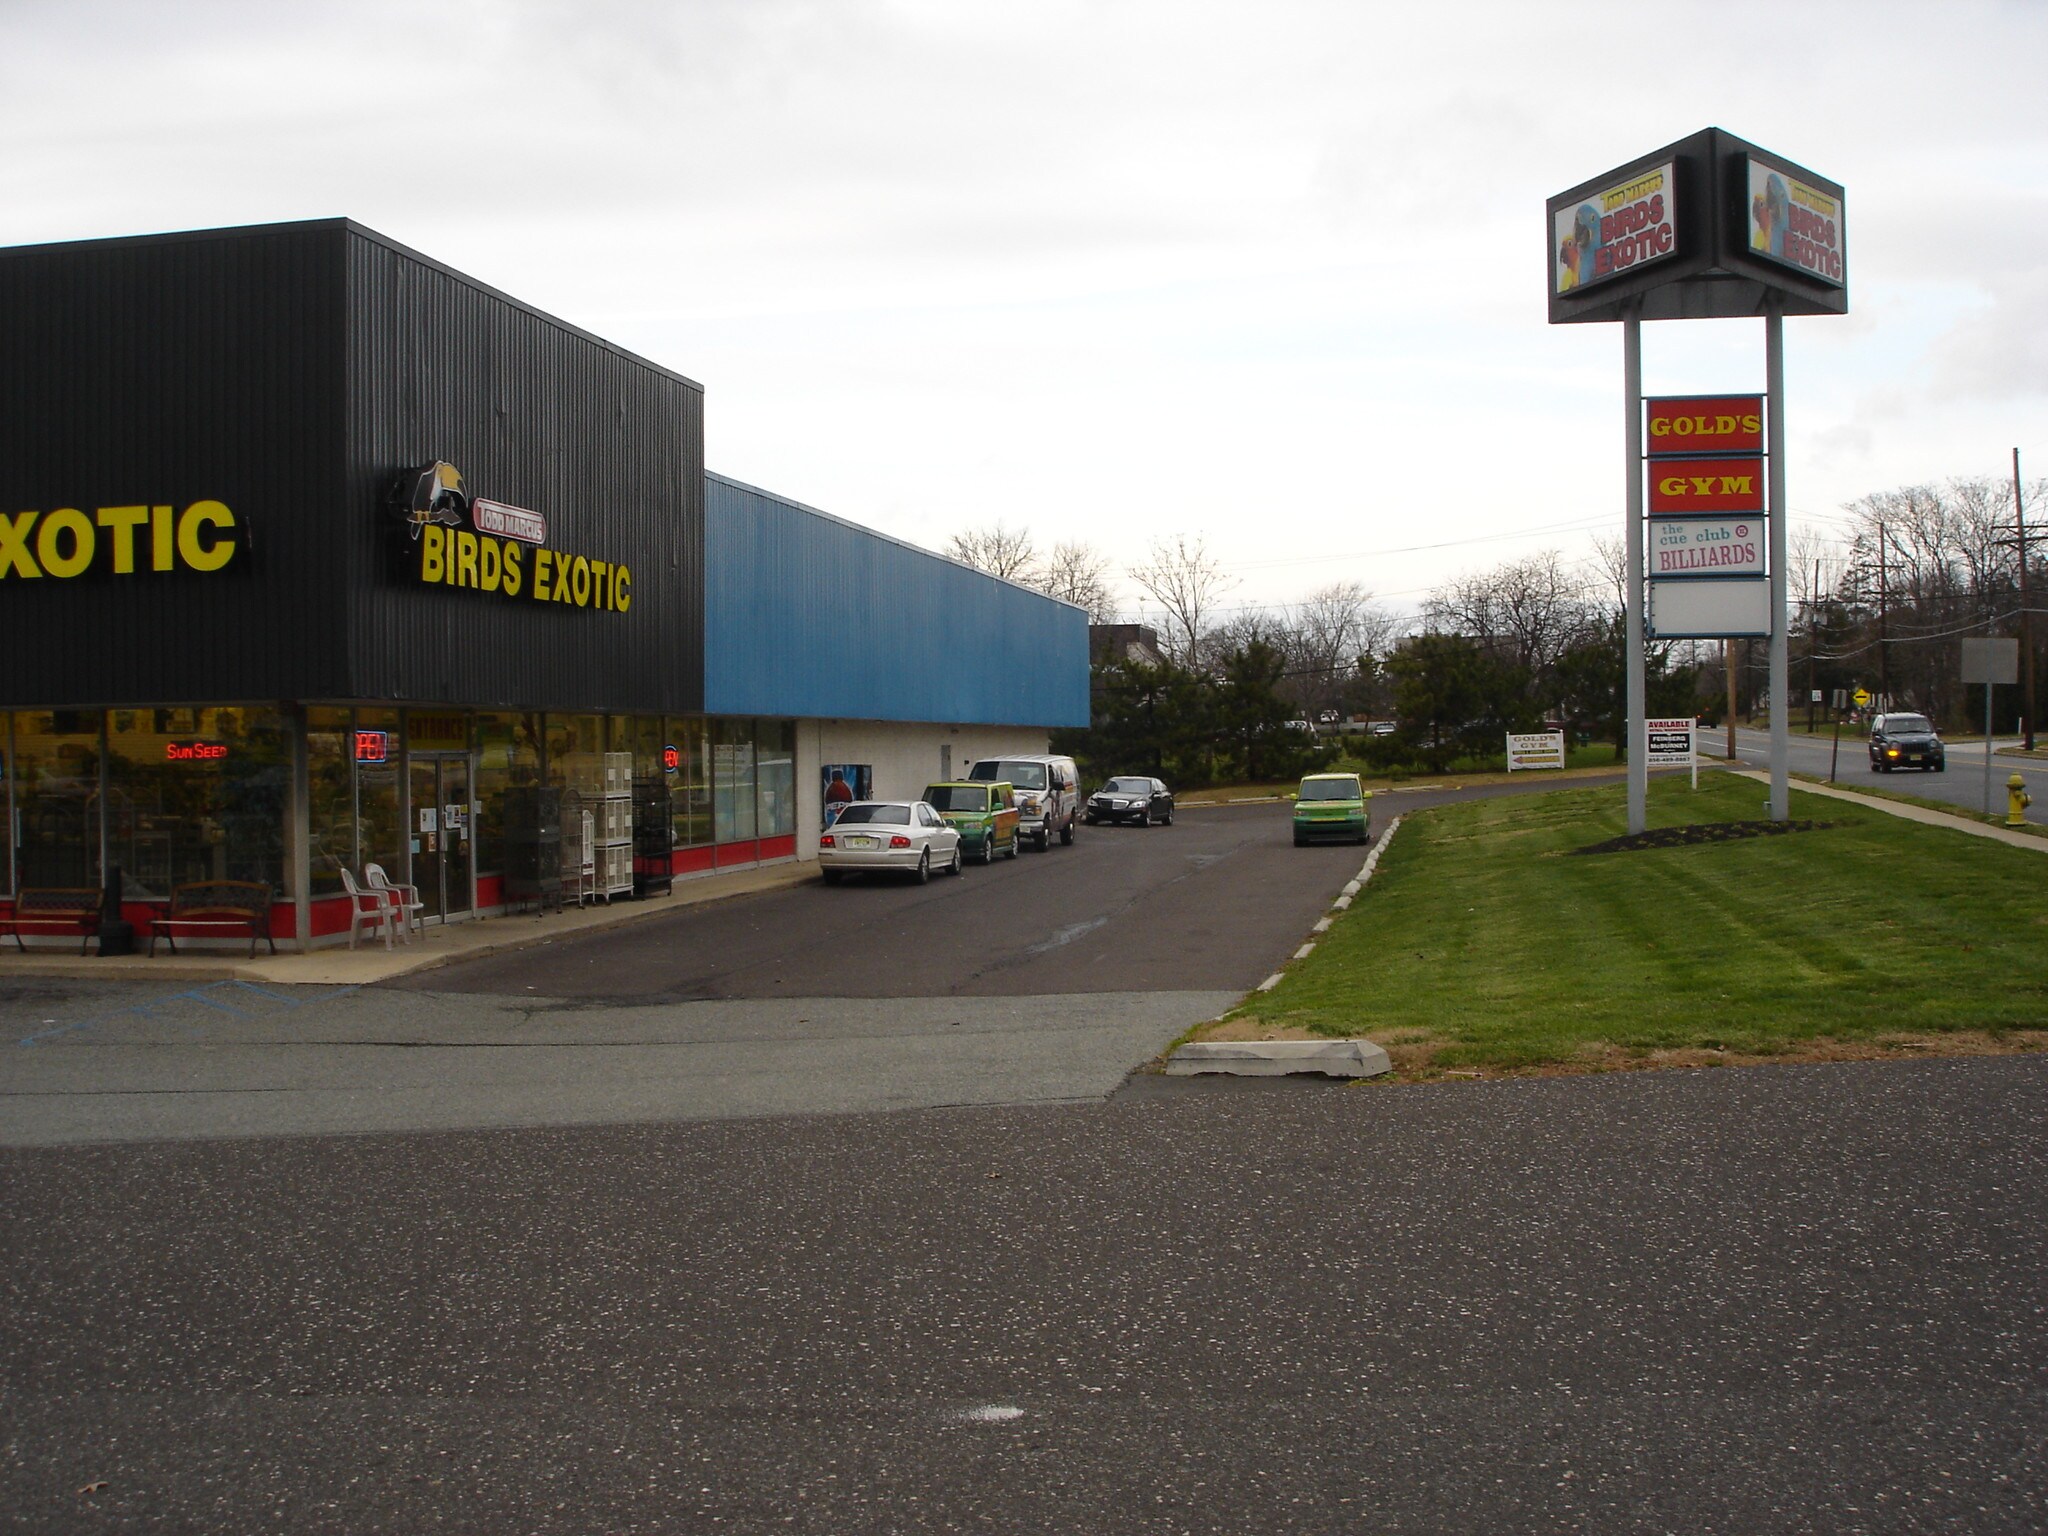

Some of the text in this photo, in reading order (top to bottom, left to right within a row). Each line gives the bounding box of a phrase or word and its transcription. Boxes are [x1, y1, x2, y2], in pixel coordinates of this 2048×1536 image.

[1600, 194, 1664, 245] BIRDS
[1788, 202, 1837, 249] BIRDS
[1594, 222, 1672, 276] EXOTIC
[1783, 230, 1841, 279] EXOTIC
[1650, 414, 1761, 436] GOLD'S
[1659, 476, 1753, 496] GYM
[478, 502, 543, 540] TODD MARCUS
[1660, 535, 1687, 545] cue
[1696, 528, 1730, 542] club
[1663, 524, 1683, 534] the
[422, 524, 632, 613] BIRDS EXOTIC
[1659, 543, 1755, 571] BILLIARDS
